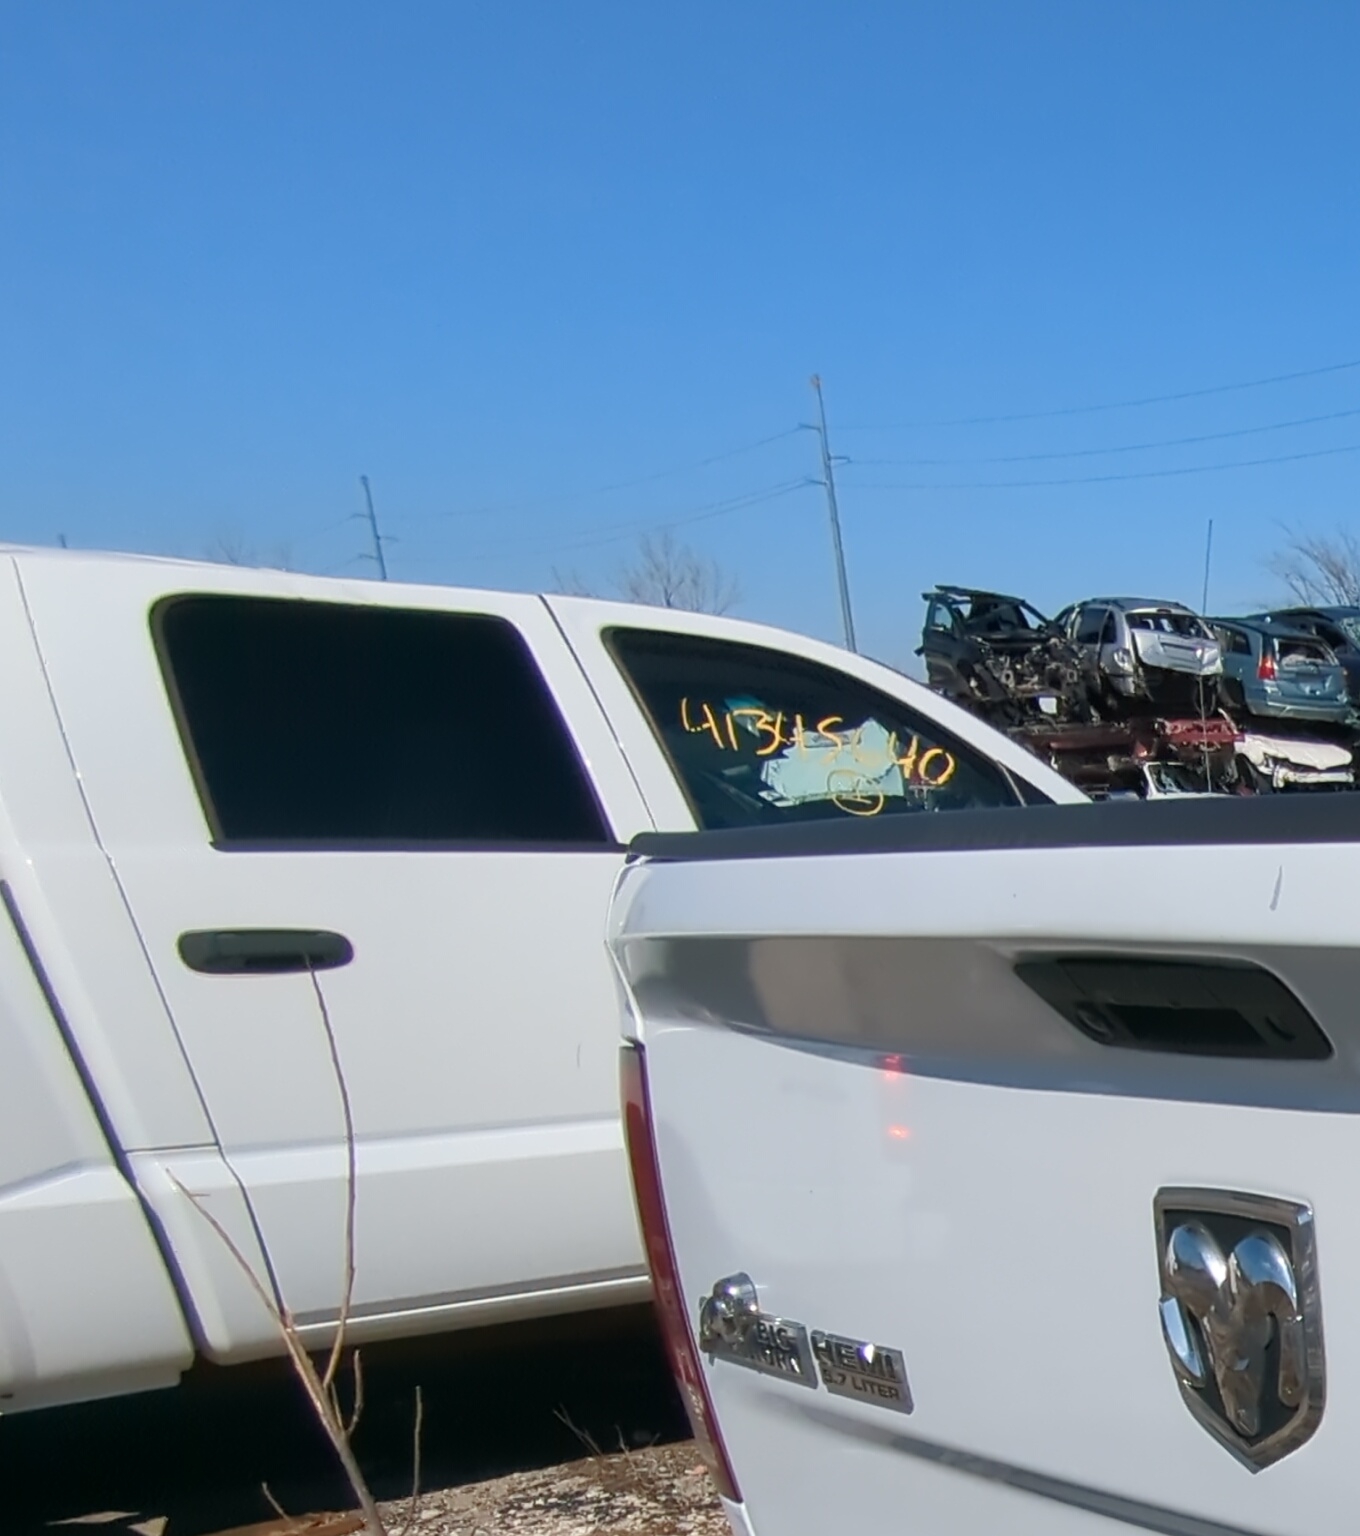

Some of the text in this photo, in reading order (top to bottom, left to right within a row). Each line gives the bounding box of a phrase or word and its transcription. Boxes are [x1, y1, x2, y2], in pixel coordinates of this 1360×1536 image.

[757, 1320, 797, 1351] BIG
[811, 1334, 897, 1379] HEMI
[823, 1369, 900, 1400] 5.7 LITER
